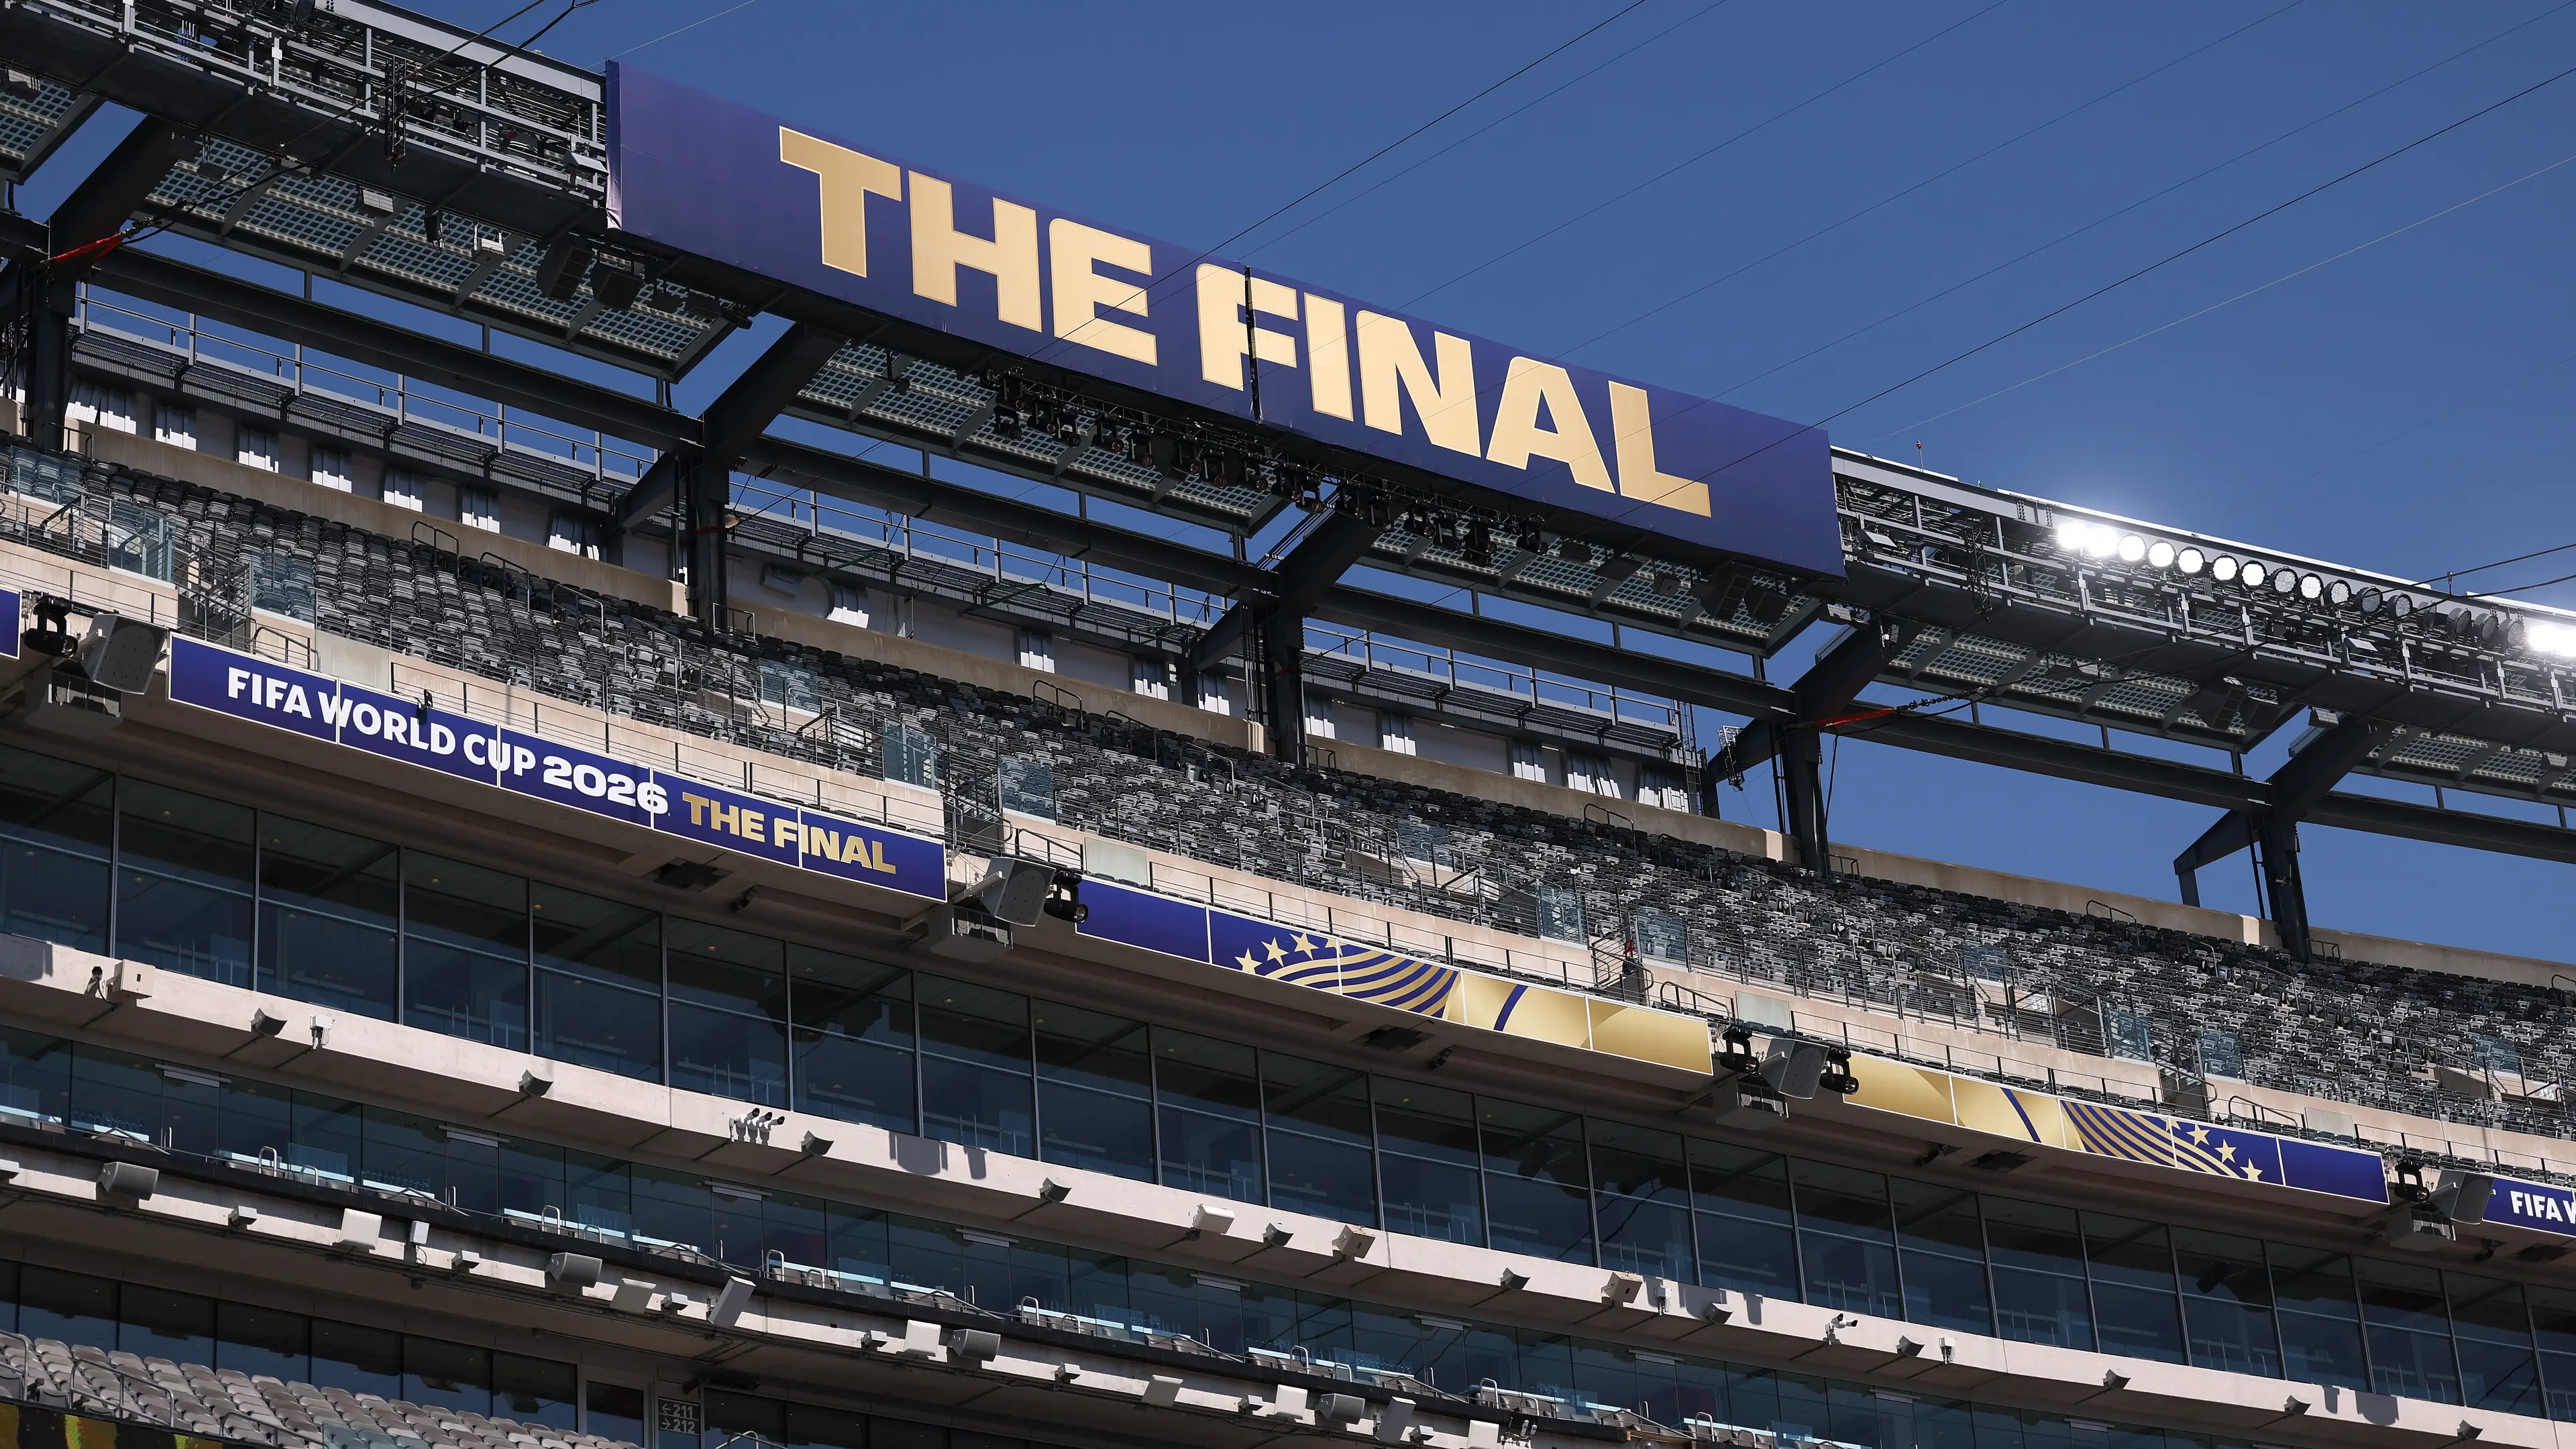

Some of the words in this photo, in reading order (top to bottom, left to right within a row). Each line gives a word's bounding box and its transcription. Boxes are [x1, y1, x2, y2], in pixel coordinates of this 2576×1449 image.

[779, 125, 1159, 366] THE
[1196, 263, 1712, 518] FINAL
[228, 666, 312, 719] FIFA
[317, 691, 456, 755] WORLD
[463, 733, 536, 777] CUP
[542, 755, 668, 814] 2026
[682, 792, 766, 843] THE
[774, 817, 896, 874] FINAL
[2510, 1190, 2563, 1222] FIFA
[673, 1403, 693, 1419] 211
[673, 1418, 695, 1434] 212
